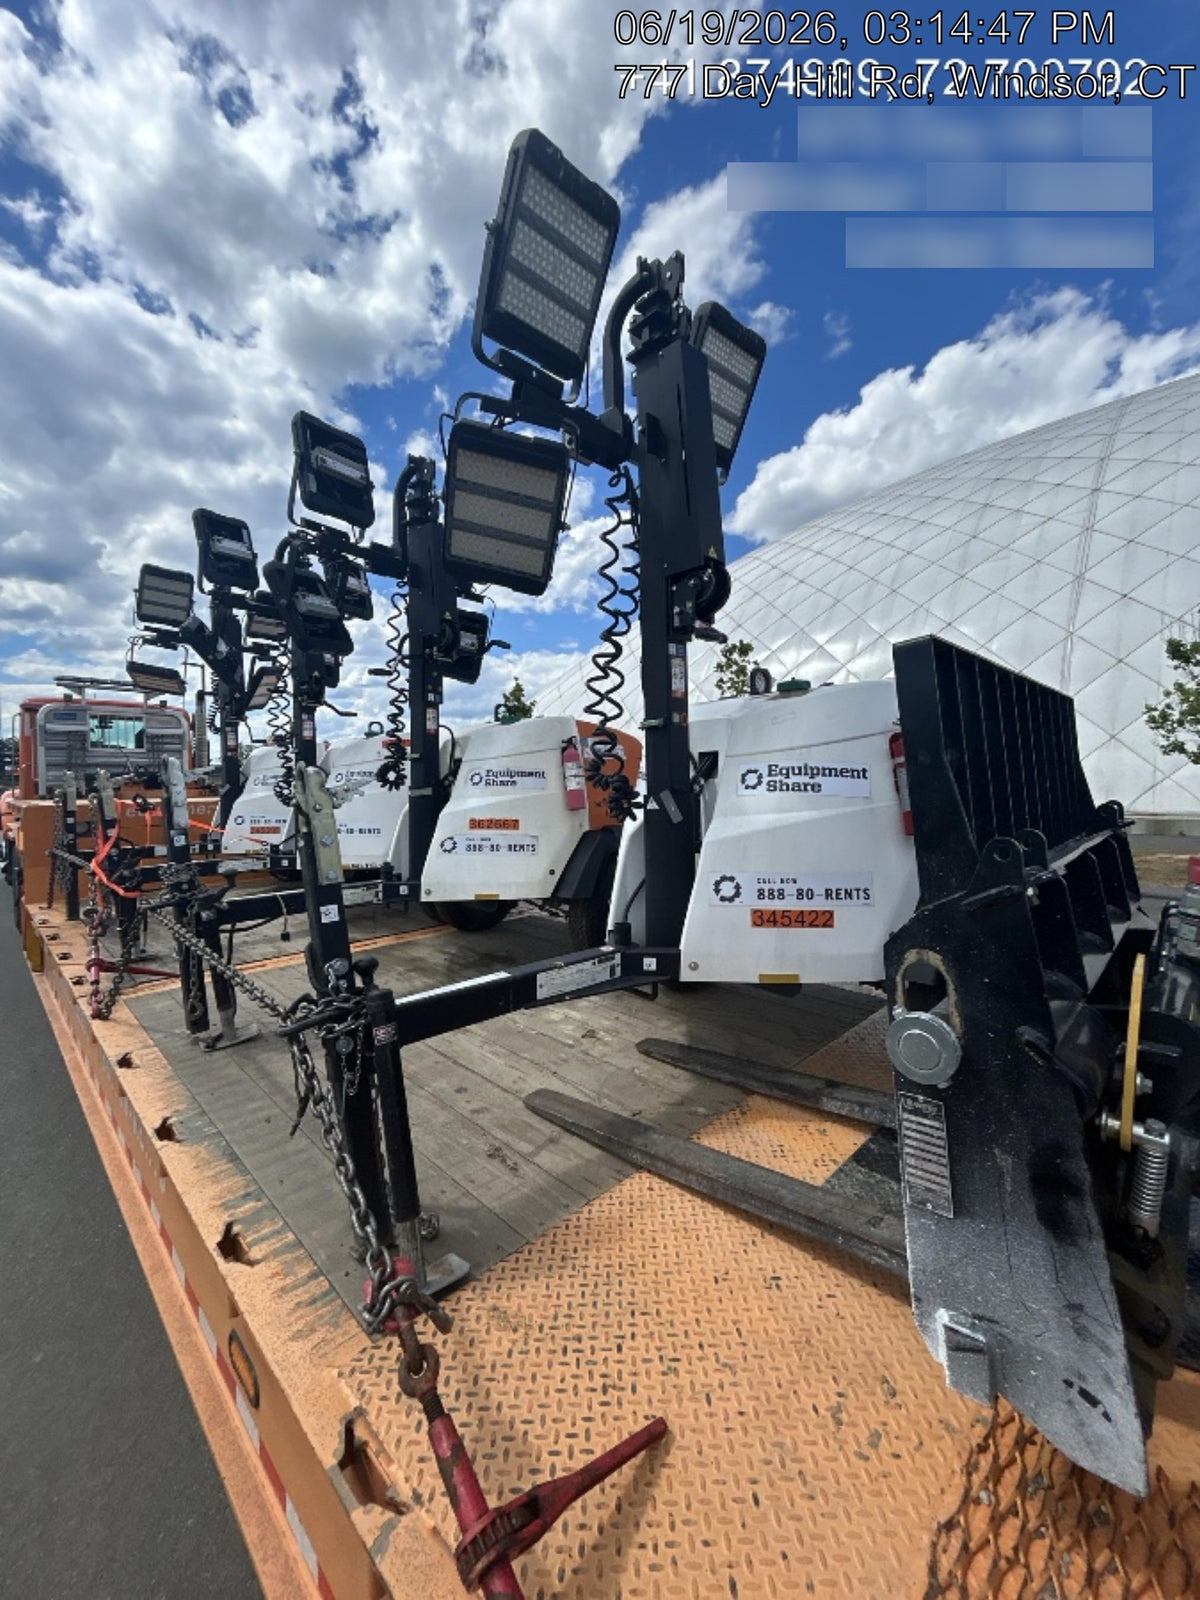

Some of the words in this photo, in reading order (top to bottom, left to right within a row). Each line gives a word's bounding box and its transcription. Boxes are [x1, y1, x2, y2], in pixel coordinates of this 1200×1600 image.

[485, 768, 546, 779] Equipment
[767, 763, 868, 780] Equipment
[766, 780, 823, 793] Share
[757, 887, 871, 901] 888-80-RENTS
[752, 910, 834, 927] 345422
